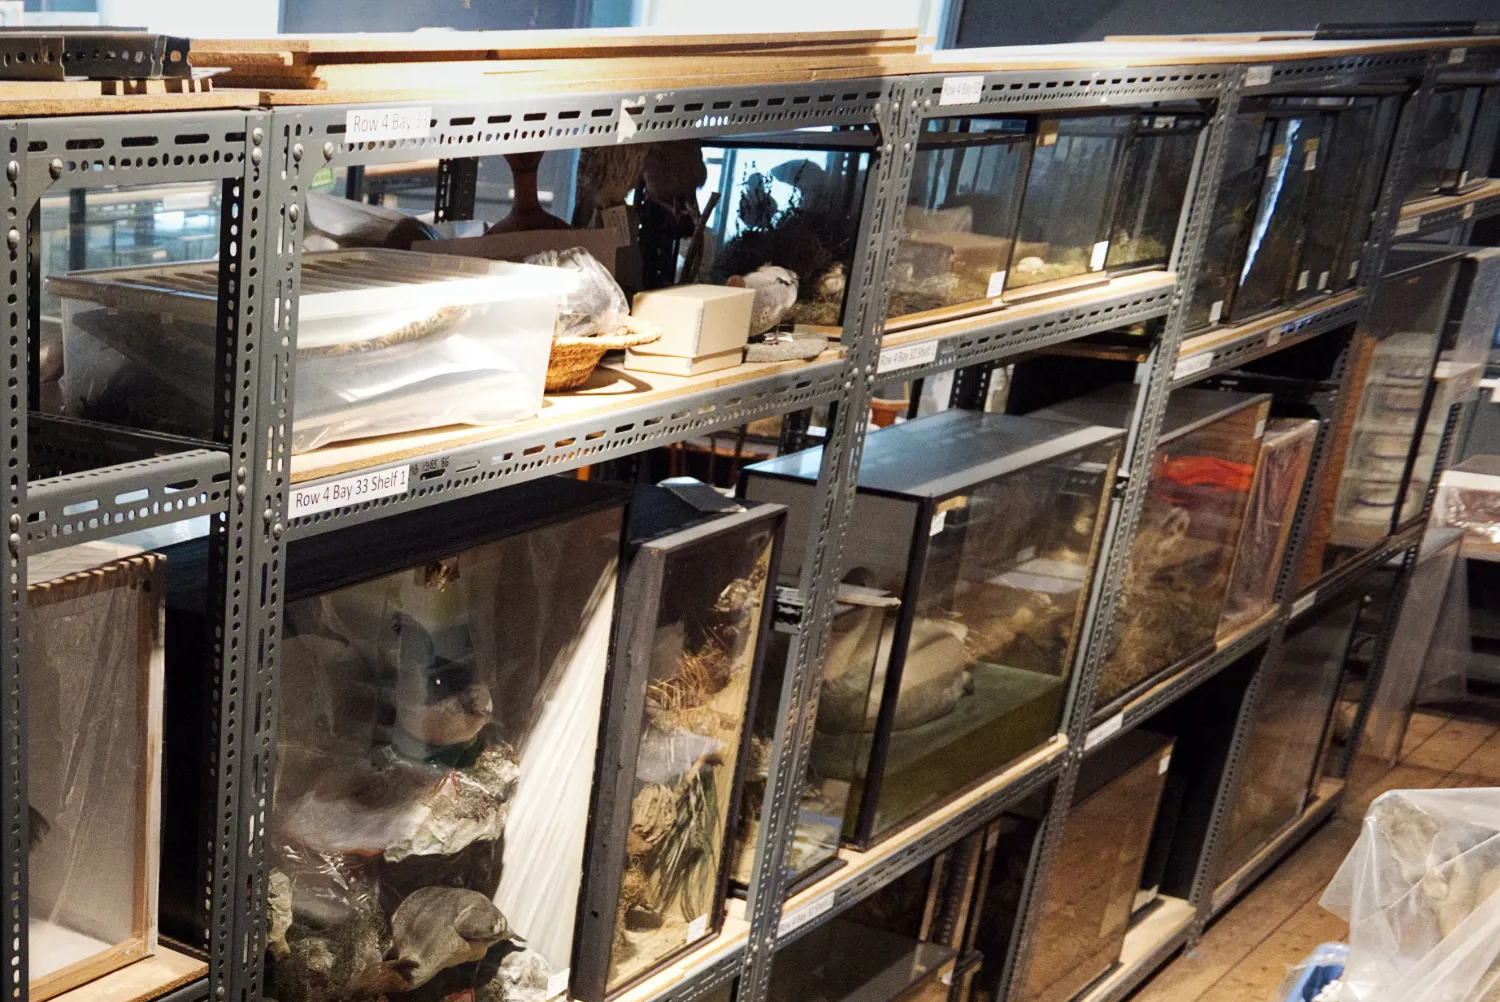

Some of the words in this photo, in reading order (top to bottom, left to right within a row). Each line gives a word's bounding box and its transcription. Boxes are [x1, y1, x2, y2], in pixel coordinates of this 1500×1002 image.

[353, 115, 378, 132] Row
[381, 114, 389, 130] 4
[392, 113, 410, 132] Bay
[295, 492, 321, 509] Row
[323, 487, 330, 502] 4
[333, 484, 353, 501] Bay
[355, 479, 368, 495] 33
[371, 473, 397, 492] Shelf
[400, 470, 406, 485] 1
